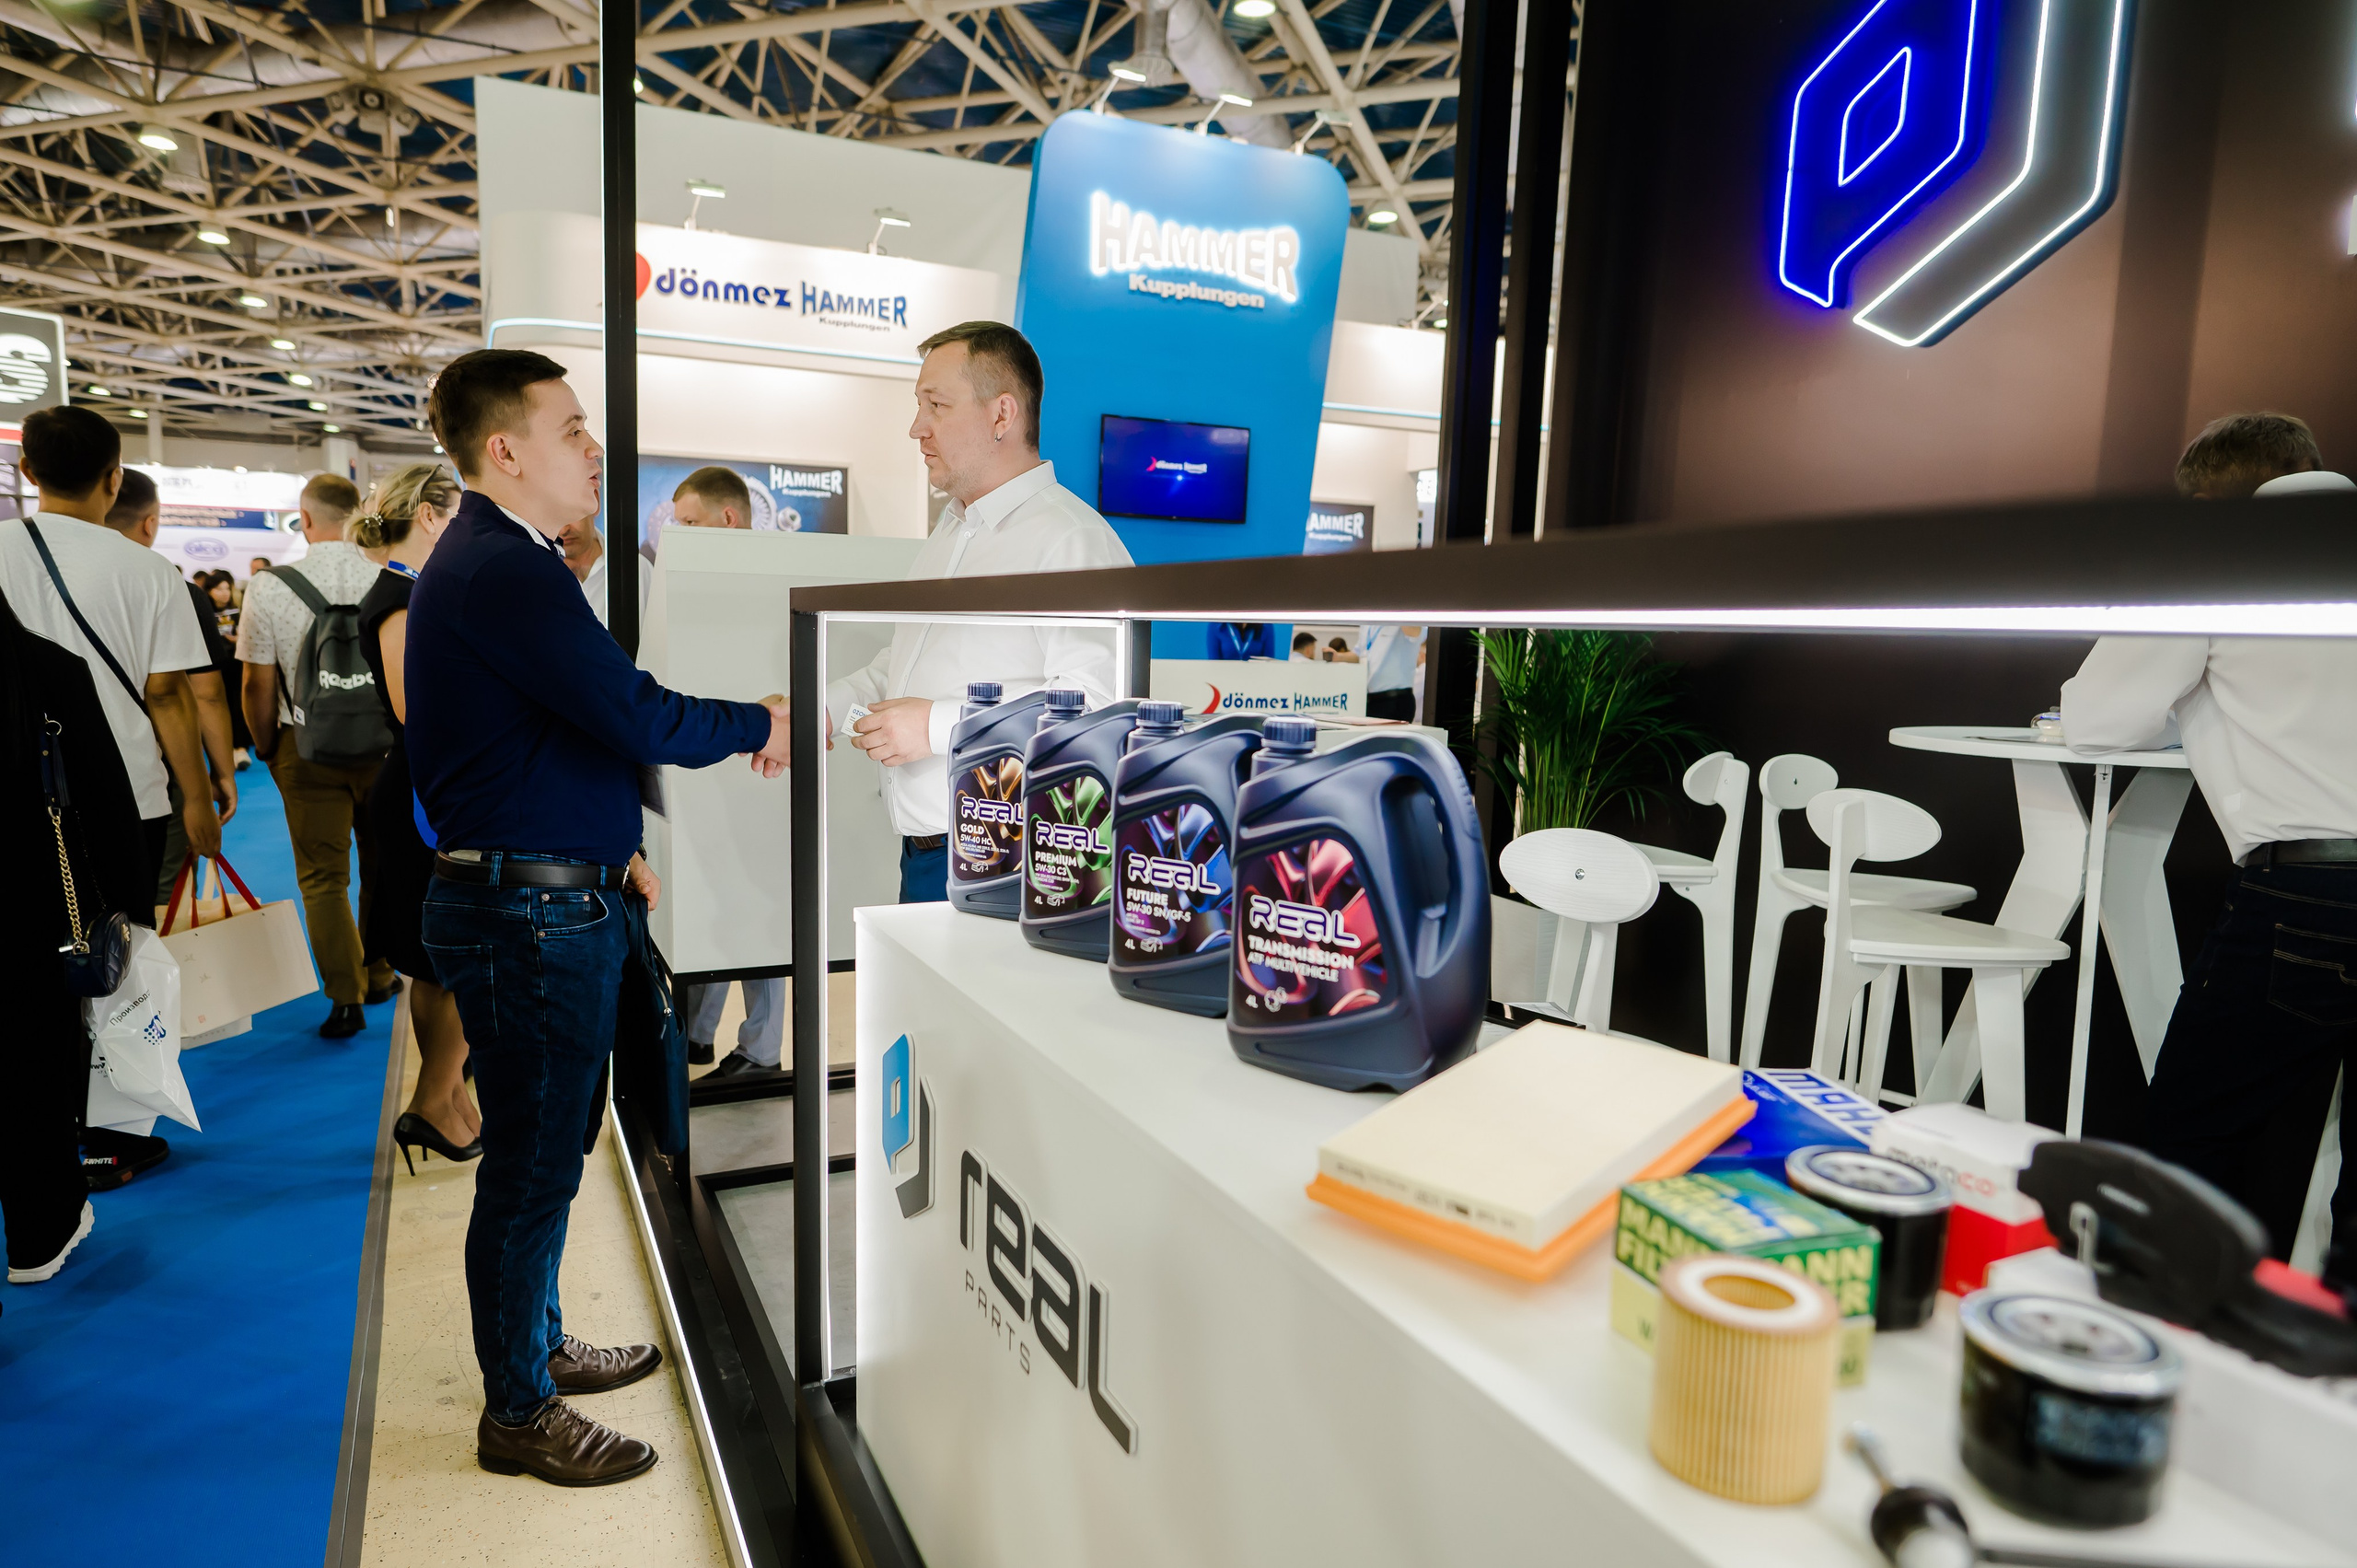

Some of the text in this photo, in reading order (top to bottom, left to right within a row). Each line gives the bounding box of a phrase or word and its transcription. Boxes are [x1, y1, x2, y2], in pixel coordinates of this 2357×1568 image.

[1091, 191, 1299, 302] HAMMER
[656, 268, 908, 329] dönmez HAMMER
[1129, 273, 1265, 308] Kupplungen
[819, 317, 890, 332] Kupplungen
[770, 464, 842, 495] HAMMER
[1306, 511, 1364, 539] AMMER
[319, 669, 375, 691] Reebo
[1223, 692, 1348, 712] dönmez HAMMER
[961, 796, 1024, 826] REAL
[960, 823, 985, 835] GOLD
[960, 833, 992, 846] 5W-40 HC
[1036, 820, 1110, 854] REAL
[959, 863, 968, 871] 4L
[1035, 851, 1077, 866] PREMIUM
[1035, 863, 1067, 877] 5W-30 C3
[1128, 853, 1221, 896] REAL
[1034, 896, 1043, 905] 4L
[1126, 888, 1168, 906] FUTURE
[1126, 901, 1153, 915] 5W-30
[1153, 904, 1191, 923] SN/GF-5
[1249, 894, 1361, 949] REAL
[1125, 938, 1136, 950] 4L
[1248, 935, 1354, 970] TRANSMISSION
[1248, 951, 1339, 982] ATF MULTIVEHICLE
[110, 990, 151, 1026] Производ
[960, 1148, 1137, 1455] real
[965, 1269, 1031, 1376] PARTS
